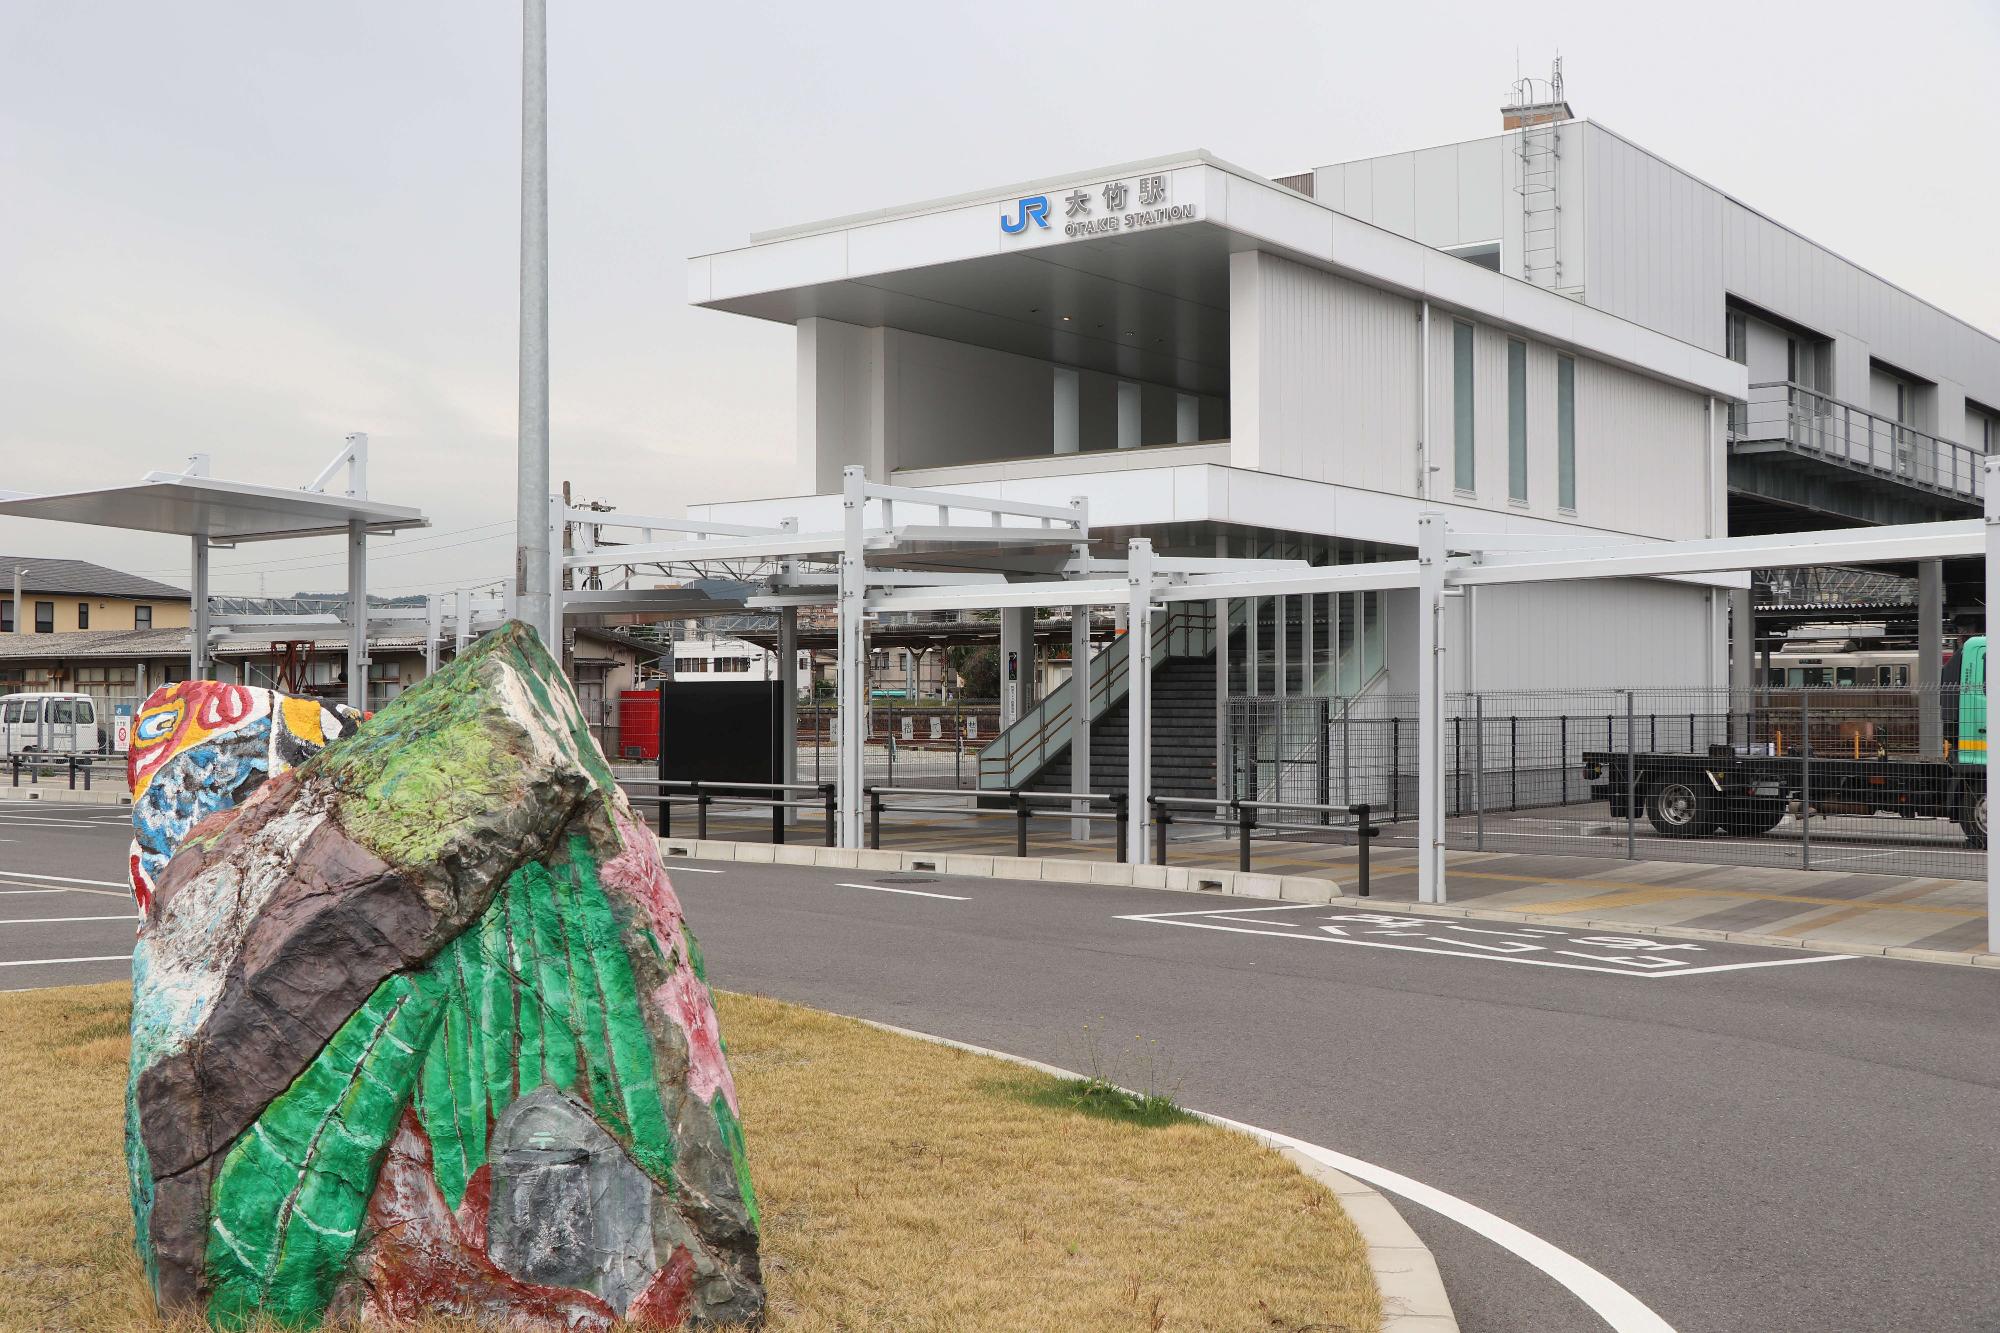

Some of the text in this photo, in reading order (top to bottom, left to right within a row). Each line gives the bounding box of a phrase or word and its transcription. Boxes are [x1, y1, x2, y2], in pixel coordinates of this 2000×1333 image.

[1001, 195, 1049, 233] JR
[1065, 176, 1164, 216] 大竹駅
[1124, 203, 1193, 227] STATION
